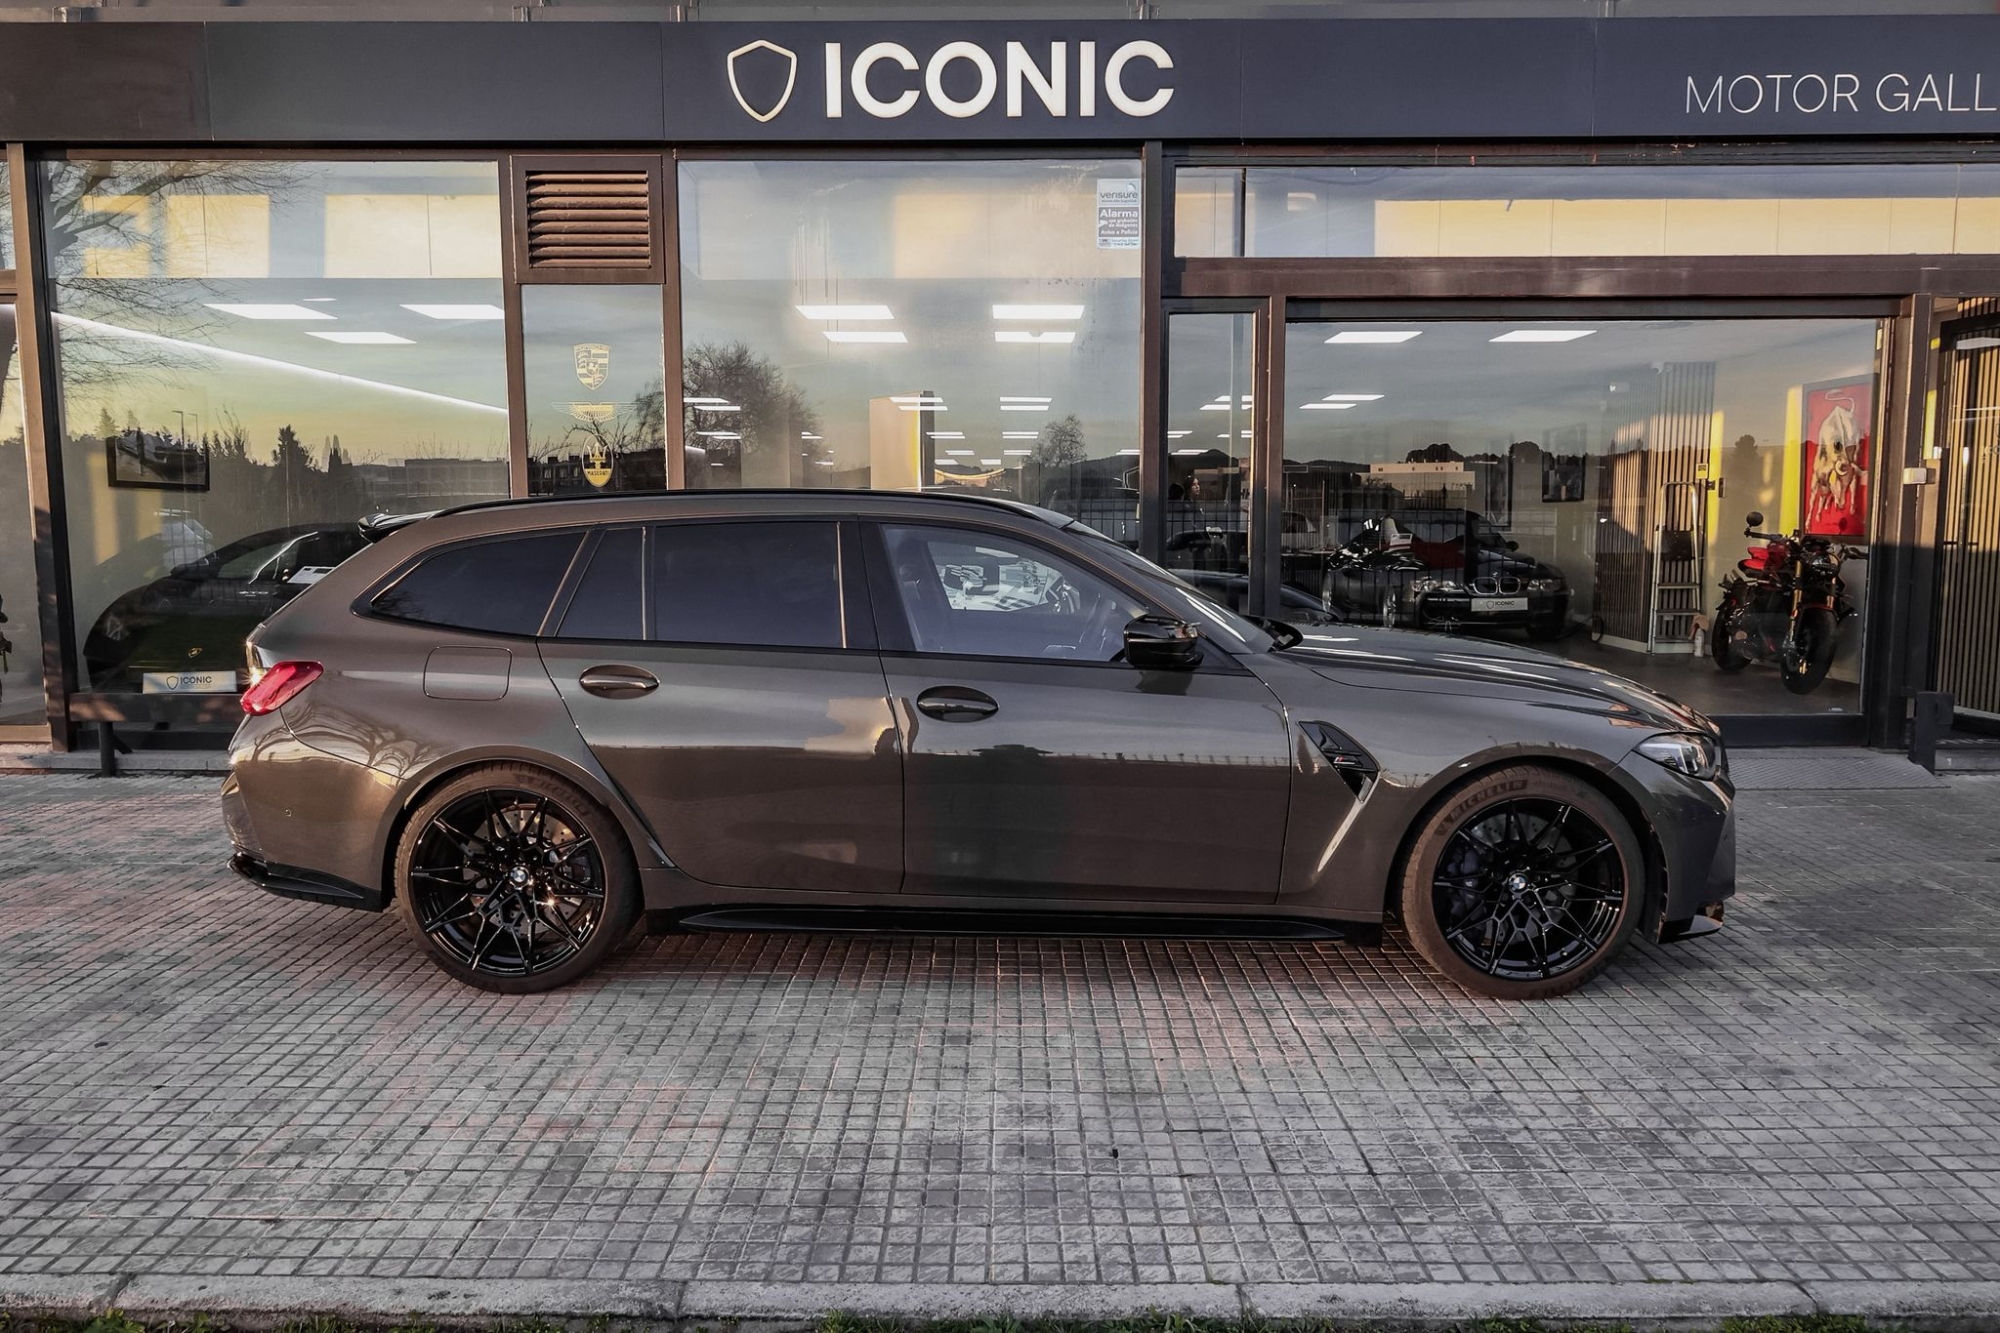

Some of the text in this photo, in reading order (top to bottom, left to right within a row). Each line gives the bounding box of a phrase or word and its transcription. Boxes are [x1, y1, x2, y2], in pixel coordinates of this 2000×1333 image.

[824, 39, 1176, 119] ICONIC
[1685, 73, 1998, 114] MOTOR GALL
[1100, 191, 1139, 199] verisure
[1100, 208, 1138, 218] Alarma
[180, 676, 212, 684] ICONIC
